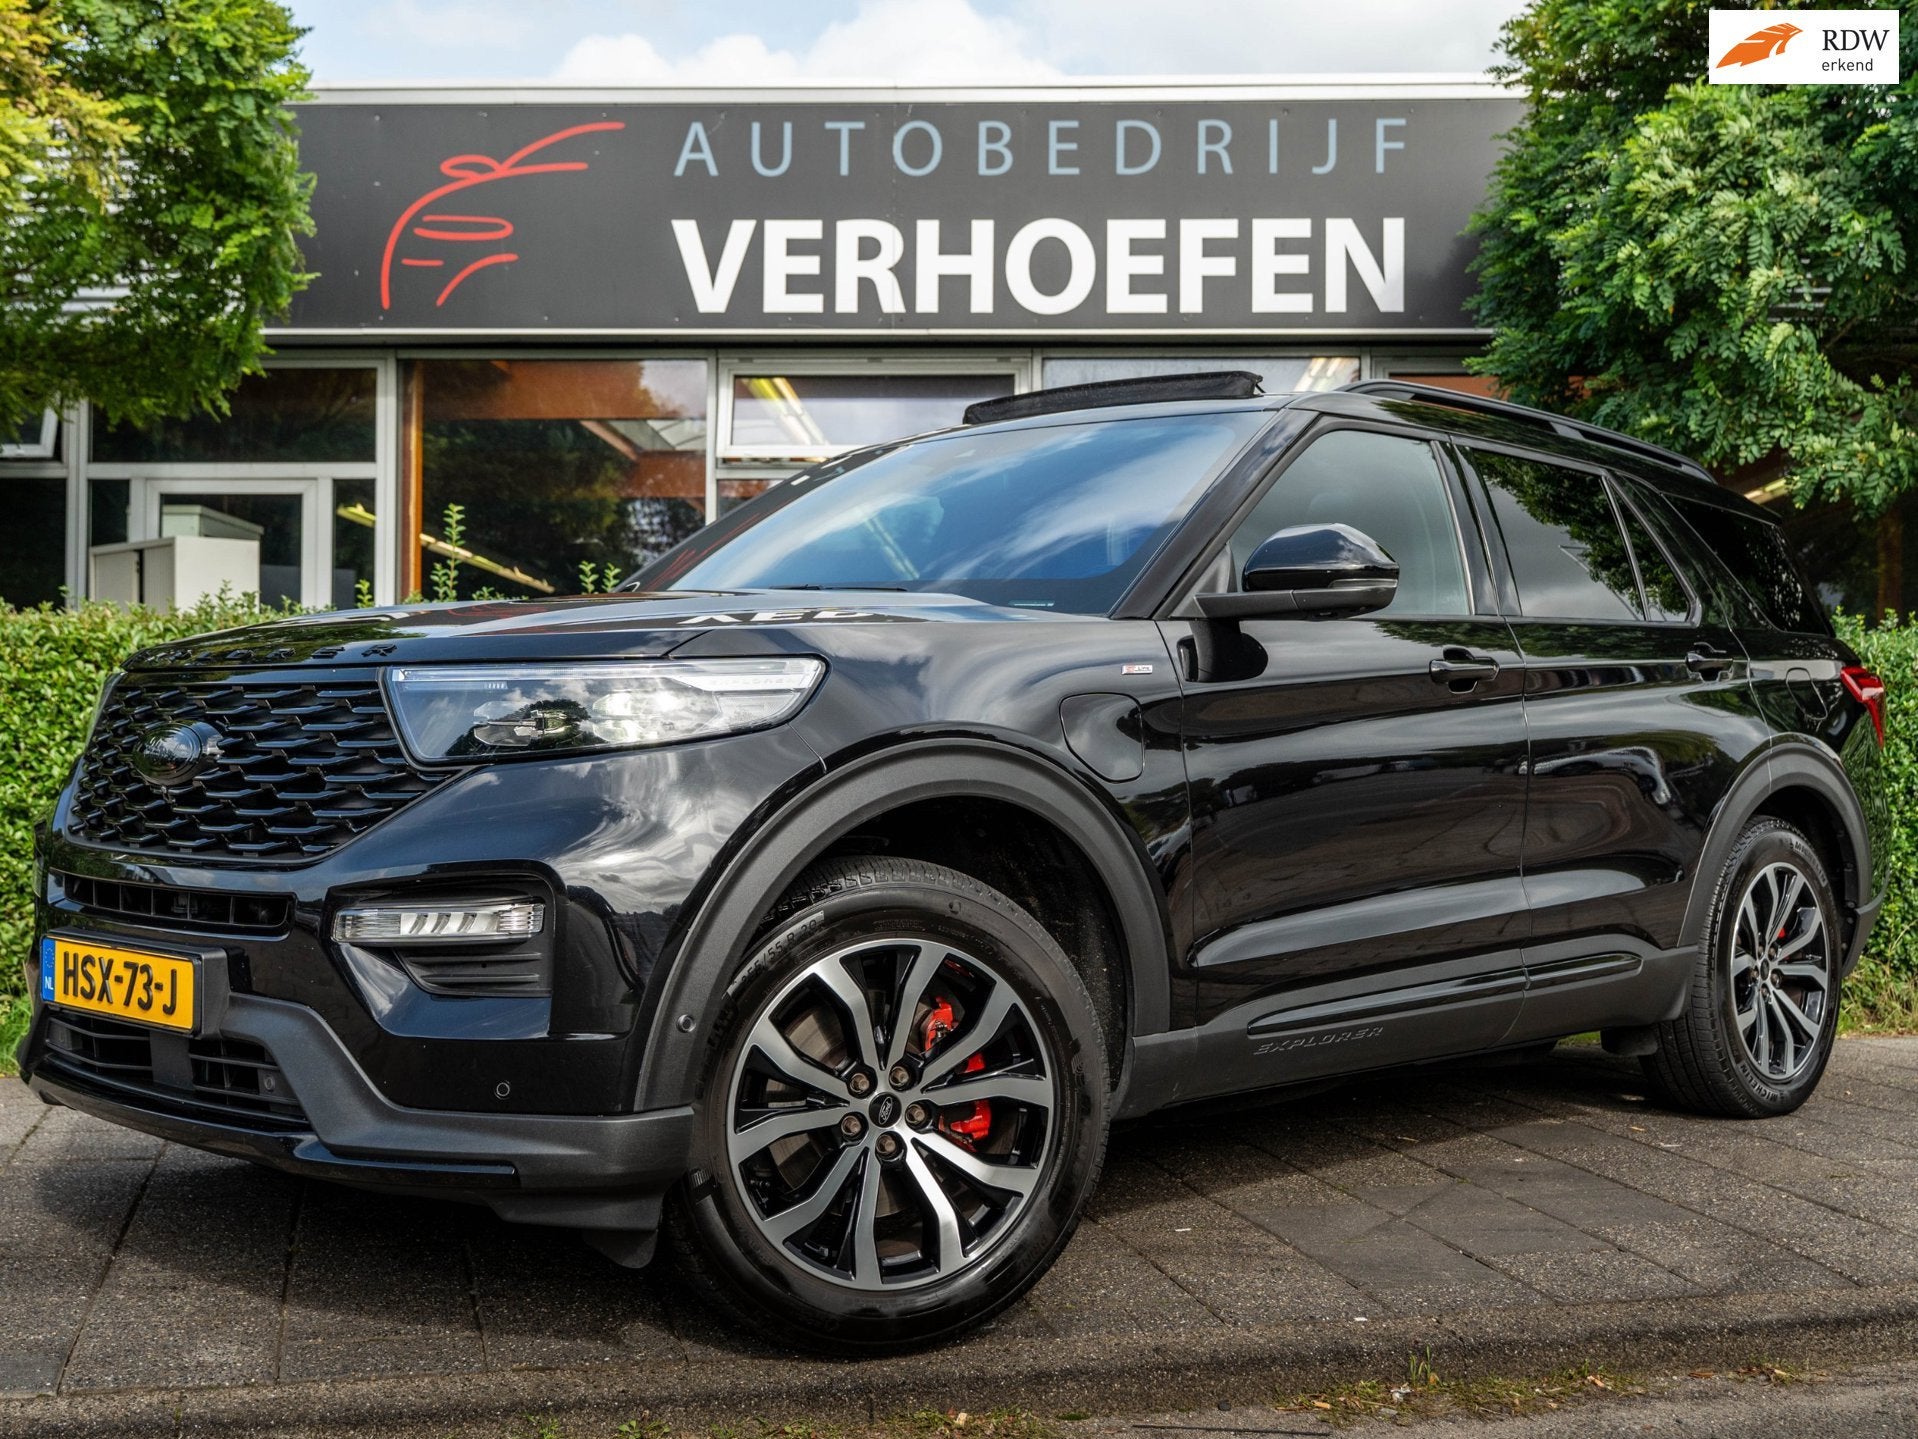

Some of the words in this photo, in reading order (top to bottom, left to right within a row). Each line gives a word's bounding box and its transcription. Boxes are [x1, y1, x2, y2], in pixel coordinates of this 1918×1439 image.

[674, 118, 1407, 177] AUTOBEDRIJF
[671, 217, 1405, 315] VERHOEFEN
[63, 950, 178, 1016] HSX-73-J
[1253, 1026, 1384, 1055] EXPLORER
[1739, 1064, 1779, 1102] MICHELIN
